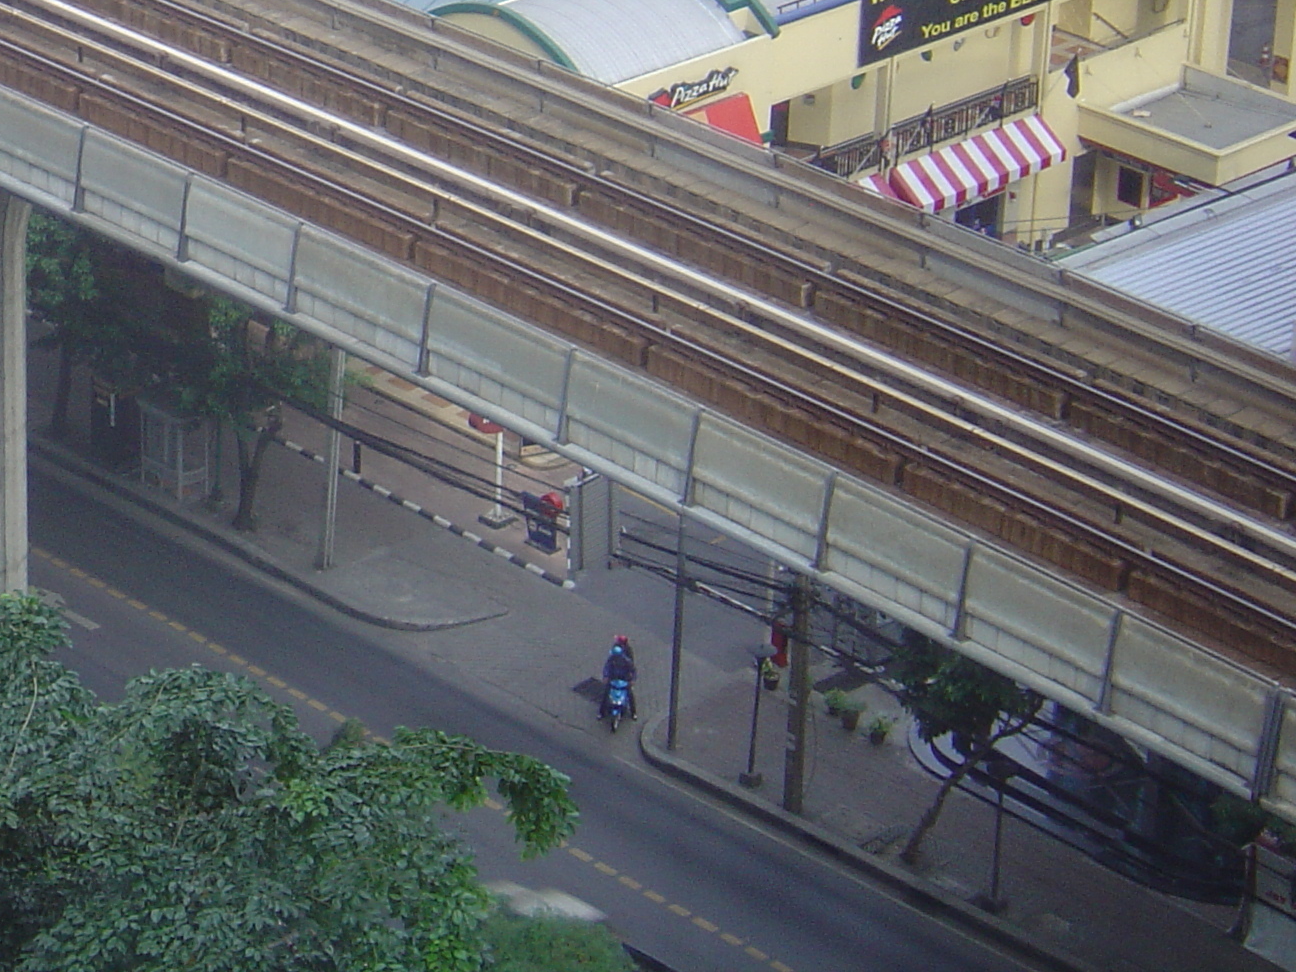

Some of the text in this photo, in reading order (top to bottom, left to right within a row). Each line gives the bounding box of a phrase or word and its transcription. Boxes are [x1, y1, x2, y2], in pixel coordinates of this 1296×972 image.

[872, 15, 902, 44] Pizza
[921, 21, 951, 39] You
[954, 12, 979, 28] are
[982, 0, 1007, 18] the
[671, 70, 737, 108] Pizza Hut
